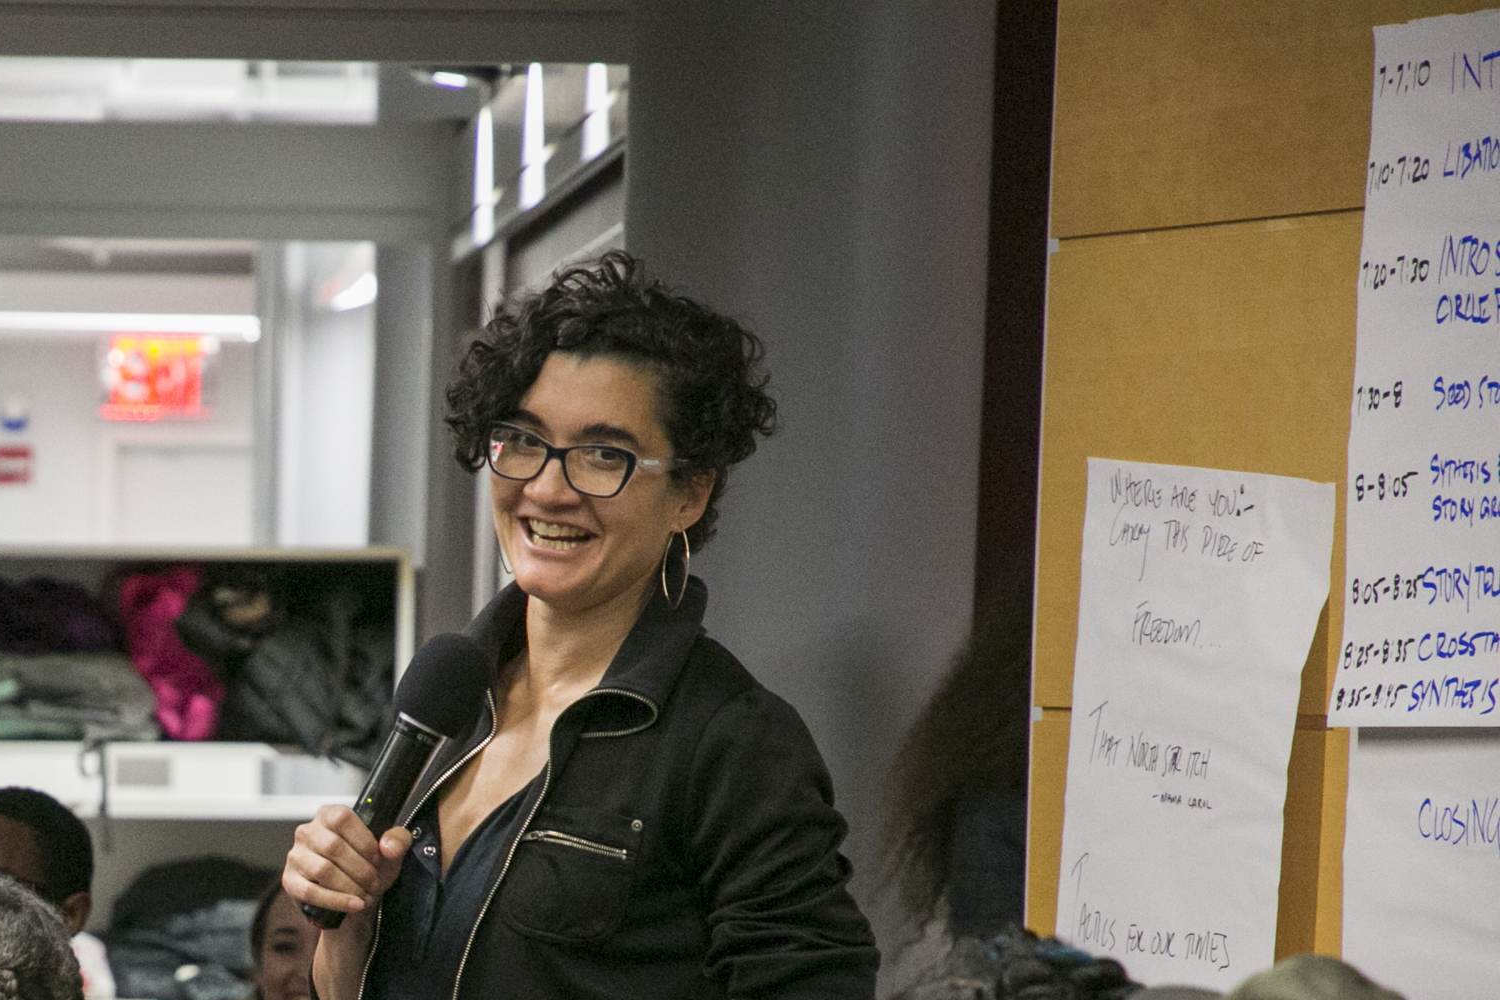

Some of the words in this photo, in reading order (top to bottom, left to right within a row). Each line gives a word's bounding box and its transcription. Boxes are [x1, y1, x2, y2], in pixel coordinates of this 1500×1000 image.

[1438, 235, 1490, 284] INTRO
[1110, 468, 1163, 509] WHERE
[1171, 485, 1199, 512] ARE
[1432, 495, 1475, 528] STORY
[1241, 541, 1264, 562] OF
[1418, 797, 1500, 860] CLOSING
